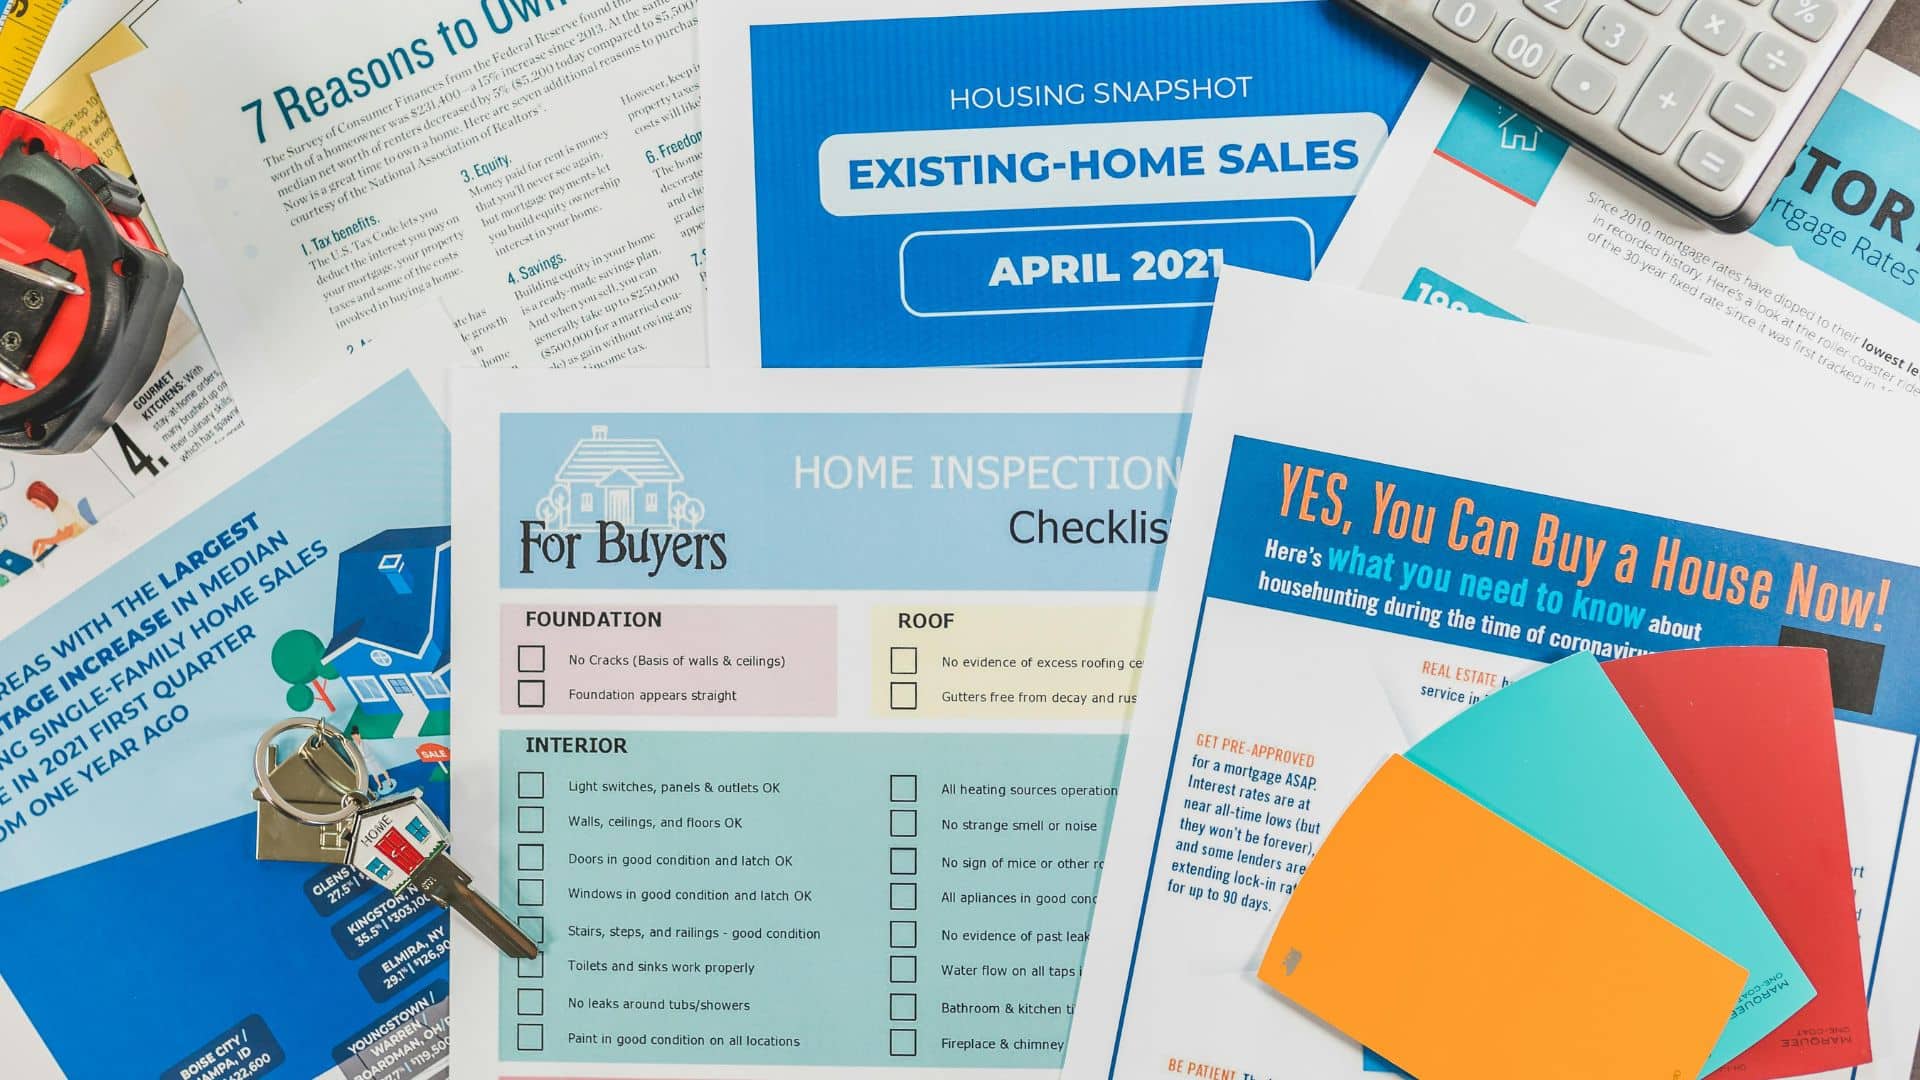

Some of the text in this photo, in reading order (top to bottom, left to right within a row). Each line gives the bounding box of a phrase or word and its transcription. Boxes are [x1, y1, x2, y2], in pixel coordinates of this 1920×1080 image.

[1454, 2, 1476, 27] 0
[1506, 23, 1626, 68] 00 3
[240, 0, 567, 144] 7 Reasons to Ow
[262, 0, 618, 168] The Survey of Consumer Finances from the Federal Reserve found
[950, 76, 1253, 110] HOUSING SNAPSHOT
[460, 155, 512, 183] 3. Equity.
[645, 150, 659, 164] 6.
[849, 139, 1359, 190] EXISTING-HOME SALES
[1785, 144, 1920, 252] TOR
[310, 235, 332, 251] Tax
[330, 215, 380, 242] benefits.
[1766, 197, 1919, 286] rtgage Rates
[508, 253, 567, 285] 4. Savings.
[988, 248, 1224, 286] APRIL 2021
[1587, 191, 1905, 369] Since 2010, mortgage rates have dipped to their lowest
[133, 370, 174, 410] GOURMET
[141, 381, 184, 421] KITCHENS:
[111, 422, 169, 477] 4.
[795, 454, 1182, 491] HOME INSPECTION
[1009, 509, 1172, 544] Checklis
[519, 520, 728, 577] For Buyers
[1280, 465, 1891, 634] YES, You Can Buy a House Now!
[50, 612, 113, 659] WITH
[111, 581, 159, 618] THE
[157, 511, 259, 590] LARGEST
[1264, 538, 1703, 642] Here's what you need to know about
[58, 608, 172, 692] INCREASE
[171, 590, 199, 616] IN
[198, 530, 289, 598] MEDIAN
[526, 611, 661, 627] FOUNDATION
[898, 612, 954, 629] ROOF
[1258, 570, 1655, 660] househunting during the time of coronavir
[29, 631, 186, 747] SINGLE-FAMILY
[189, 585, 259, 640] HOME
[258, 539, 328, 594] SALES
[569, 654, 785, 669] No Cracks (Basis of walls & ceilings)
[1422, 660, 1497, 687] REAL ESTATE
[11, 767, 39, 794] IN
[39, 734, 89, 776] 2021
[88, 692, 148, 743] FIRST
[152, 624, 256, 699] QUARTER
[569, 688, 737, 703] Foundation appears straight
[29, 776, 79, 817] ONE
[77, 737, 140, 783] YEAR
[143, 704, 189, 745] AGO
[421, 750, 448, 759] SALE
[526, 736, 628, 753] INTERIOR
[1196, 733, 1315, 768] GET PRE-APPROVED
[569, 780, 780, 795] Light switches, panels & outlets OK
[941, 783, 956, 795] All
[960, 783, 1006, 797] heating
[1010, 786, 1057, 796] sources
[1192, 754, 1317, 791] for a mortgage ASAP.
[360, 814, 393, 848] HOME
[568, 887, 812, 902] Windows in good condition and latch OK
[1167, 878, 1271, 912] for up to 90 days.
[347, 894, 409, 935] KINGSTON,
[381, 925, 444, 973] ELMIRA, NY
[347, 998, 429, 1054] YOUNGSTOWN
[941, 1037, 1066, 1052] Fireplace & chimney
[179, 1034, 240, 1080] BOISE CITY
[1168, 1058, 1237, 1080] BE PATIENT
